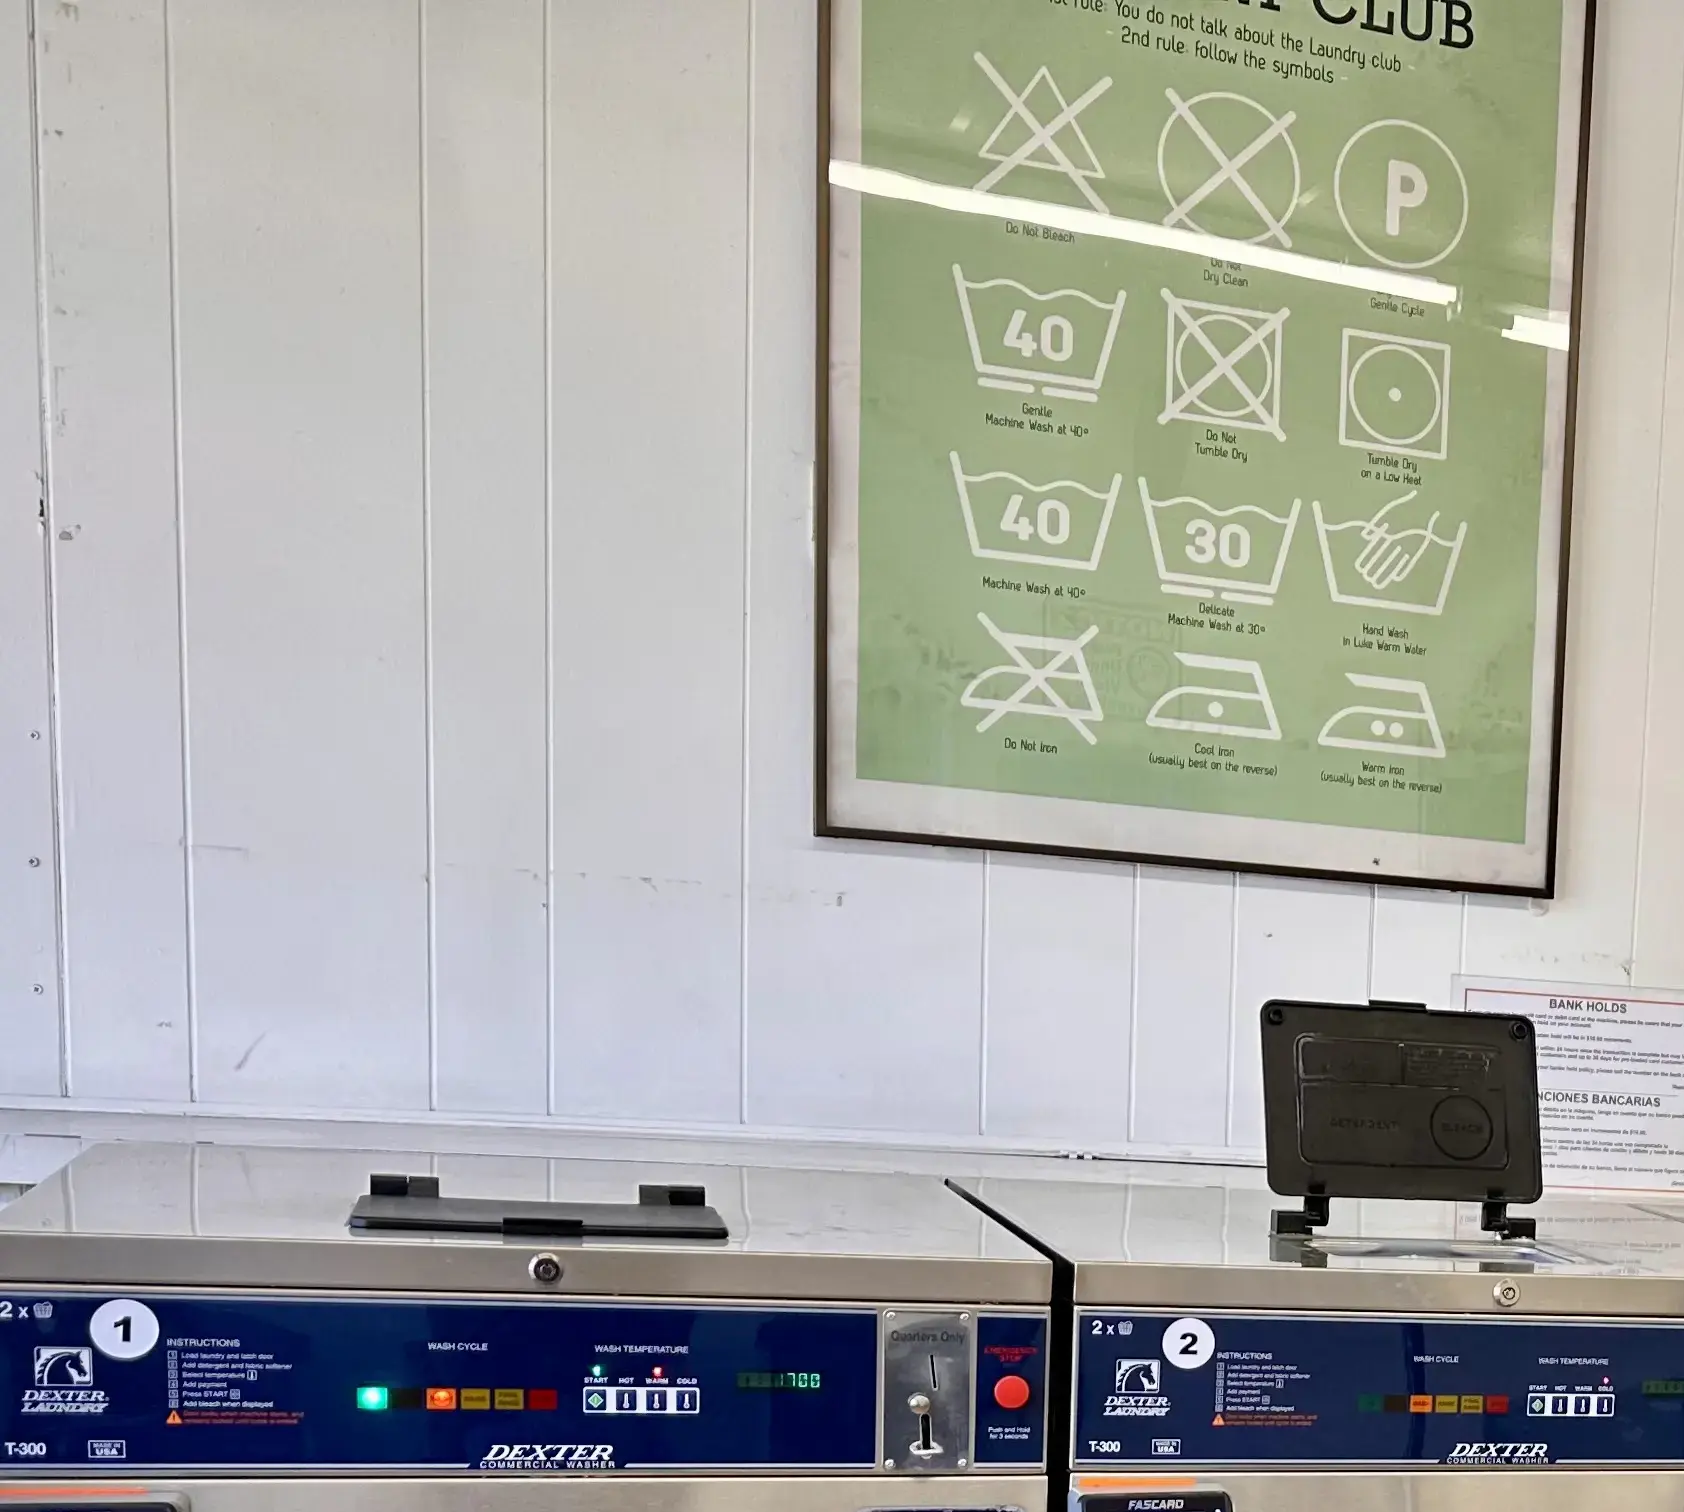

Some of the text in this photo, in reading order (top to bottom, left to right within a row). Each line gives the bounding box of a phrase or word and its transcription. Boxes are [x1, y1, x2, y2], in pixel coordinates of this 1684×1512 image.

[1313, 0, 1474, 49] CLUB
[1115, 0, 1402, 72] You do not talk about the Laundry club
[1121, 25, 1334, 83] 2nd follow the symbols
[1385, 160, 1429, 236] P
[1006, 221, 1075, 243] Do Not Bleach
[1203, 269, 1248, 287] Dry Clean
[1370, 297, 1425, 317] Gentle Cycle
[1003, 309, 1074, 362] 40
[1022, 403, 1052, 417] Gentle
[985, 413, 1067, 435] Machine Wash at
[1206, 429, 1236, 444] Do Not
[1195, 442, 1248, 463] Tumble Dry
[1367, 453, 1417, 473] Tumble Dry
[1361, 470, 1371, 478] on
[1384, 470, 1400, 482] Low
[1403, 473, 1421, 485] Heat
[1000, 494, 1070, 544] 40
[1184, 518, 1252, 568] 30
[982, 576, 1063, 596] Machine Wash at
[1198, 602, 1235, 617] Delicate
[1168, 613, 1244, 633] Machine Wash at
[1363, 623, 1408, 639] Hand Wash
[1354, 636, 1427, 656] Luke Warm Water
[1004, 737, 1057, 754] Do Not Iron
[1194, 743, 1234, 757] Cool Iron
[1149, 752, 1277, 776] (usually best on the reverse)
[1362, 761, 1404, 776] Warm Iron
[1321, 770, 1442, 794] (usually best on the reverse)
[1549, 999, 1627, 1014] BANK HOLDS
[1592, 1094, 1661, 1107] BANCARIAS
[113, 1316, 131, 1342] 1
[1092, 1320, 1102, 1335] 2
[166, 1338, 241, 1347] INSTRUCTIONS
[891, 1330, 966, 1346] Quarters Only
[1179, 1332, 1198, 1355] 2
[428, 1342, 488, 1351] WASH CYCLE
[595, 1344, 689, 1354] WASH TEMPERATURE
[1217, 1352, 1272, 1360] INSTRUCTIONS
[22, 1390, 105, 1401] DEXTER
[1104, 1396, 1168, 1406] DEXTER
[21, 1402, 109, 1413] LAUNDRY
[1103, 1407, 1171, 1416] LAUNDRY
[4, 1442, 47, 1455] T-300
[95, 1448, 118, 1456] USA
[483, 1445, 614, 1461] DEXTER
[1089, 1441, 1121, 1452] T-300
[1449, 1443, 1548, 1457] DEXTER
[480, 1461, 616, 1469] COMMERCIAL WASHER
[1128, 1500, 1184, 1510] FASCARD
